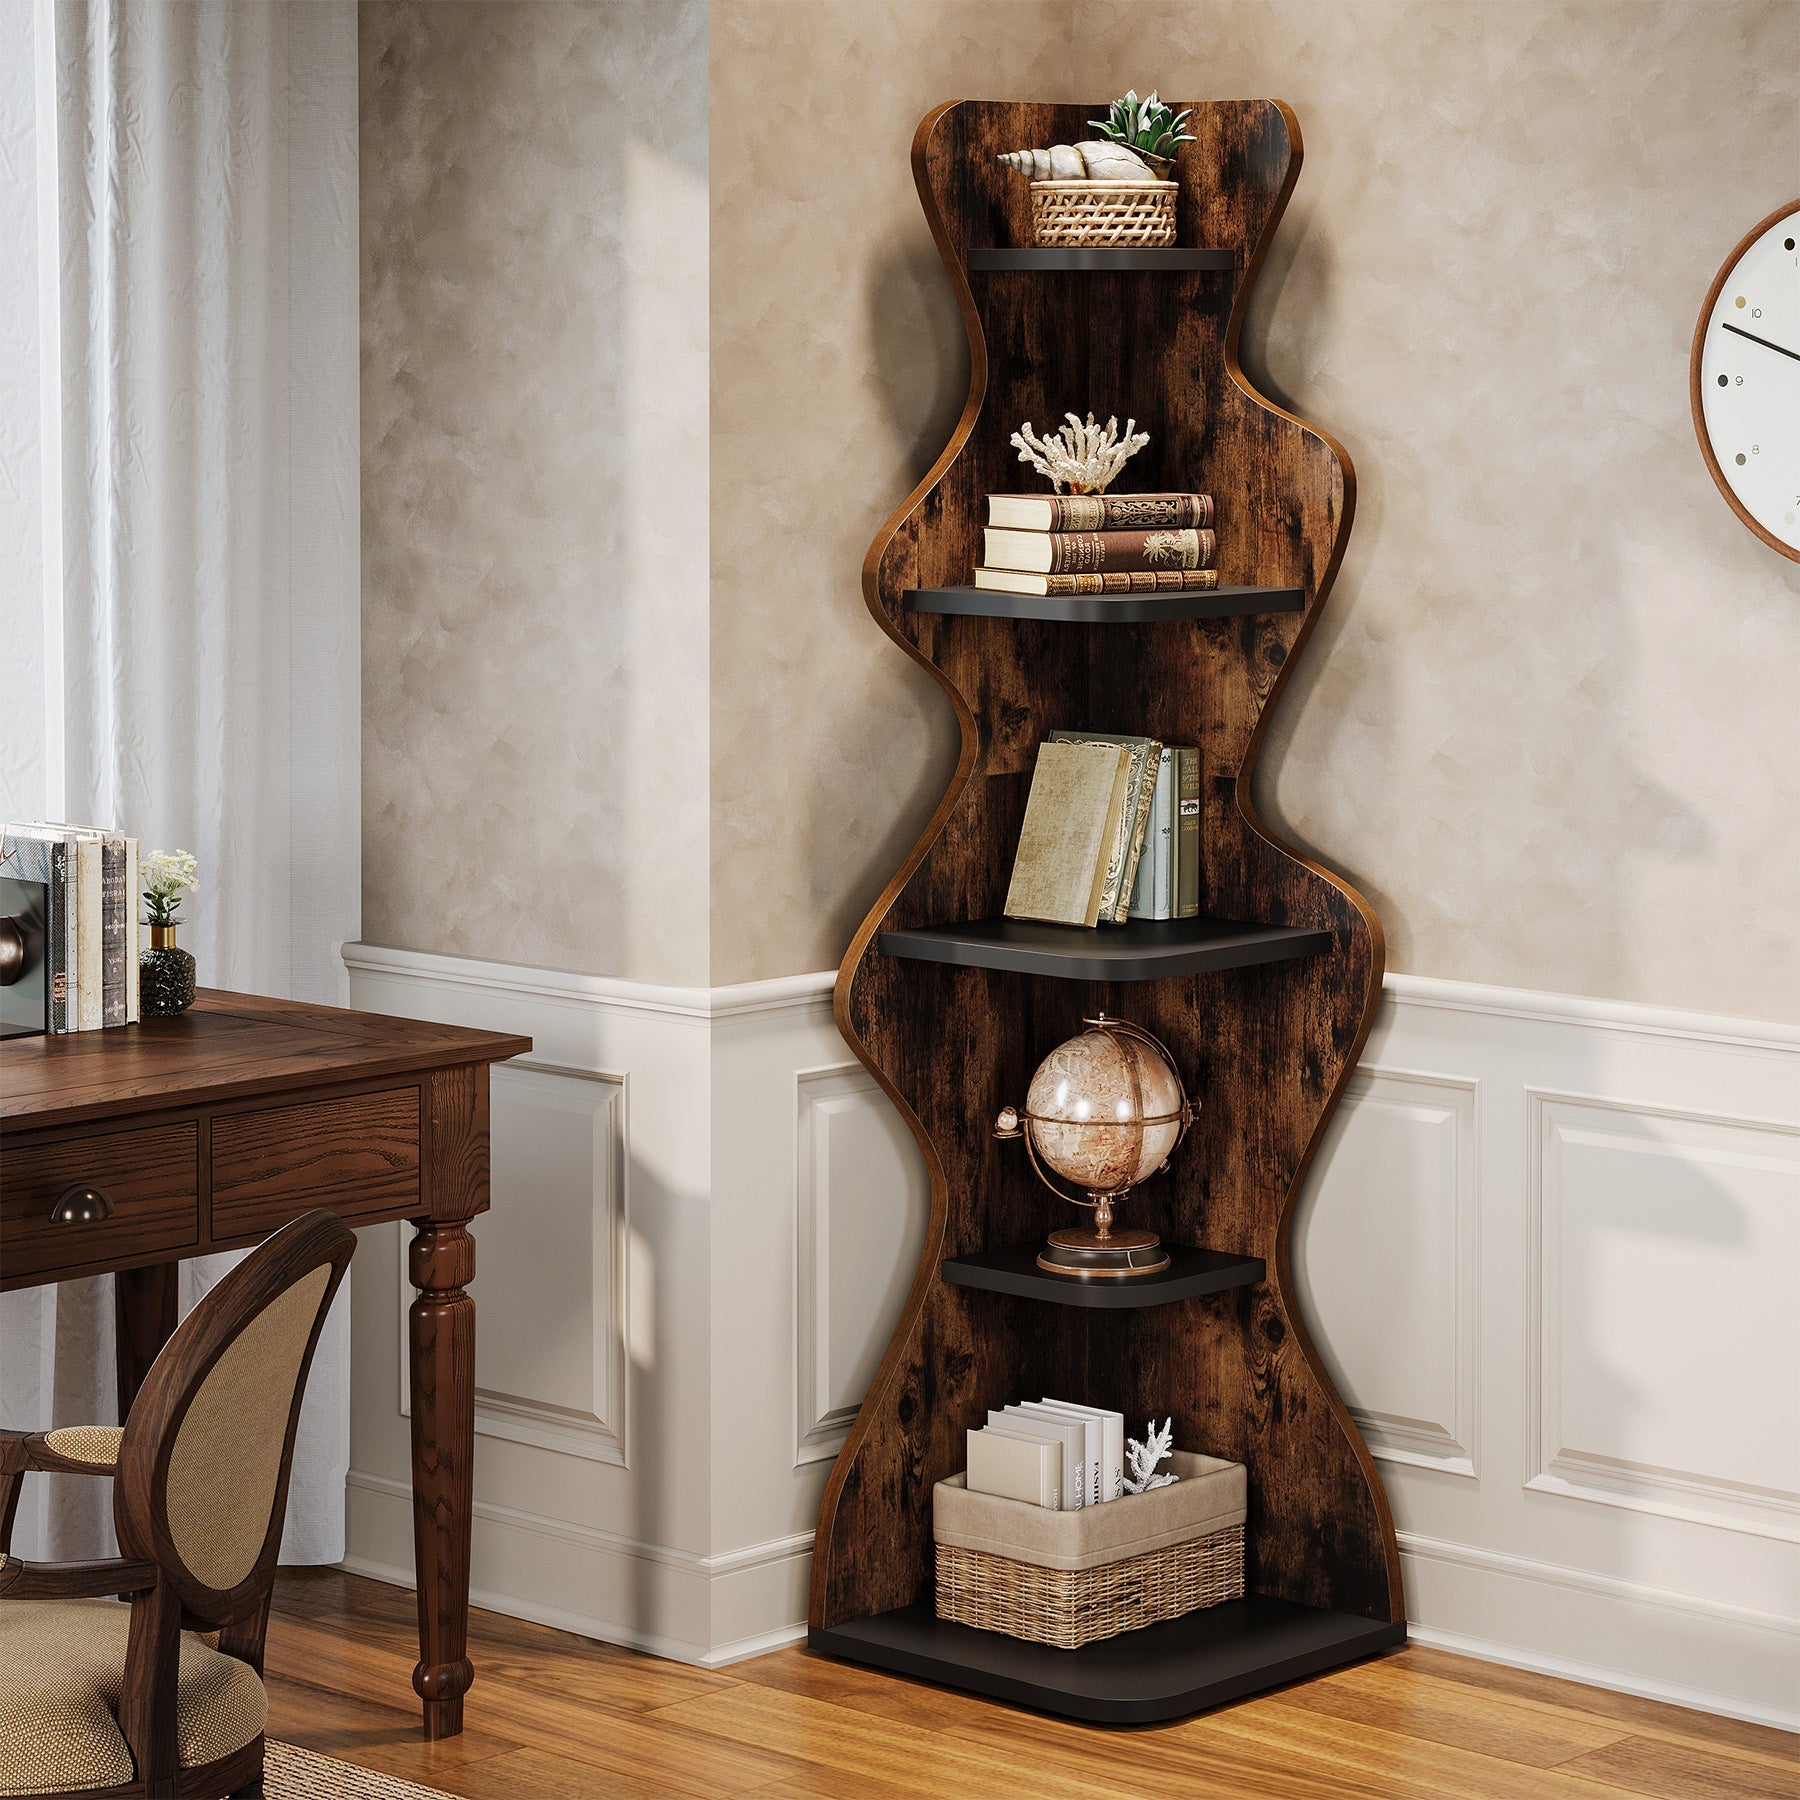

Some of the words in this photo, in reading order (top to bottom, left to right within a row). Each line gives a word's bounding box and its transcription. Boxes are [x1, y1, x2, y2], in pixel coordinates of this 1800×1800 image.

[1751, 308, 1762, 319] 10
[1735, 375, 1744, 387] 9
[1752, 444, 1760, 455] 8
